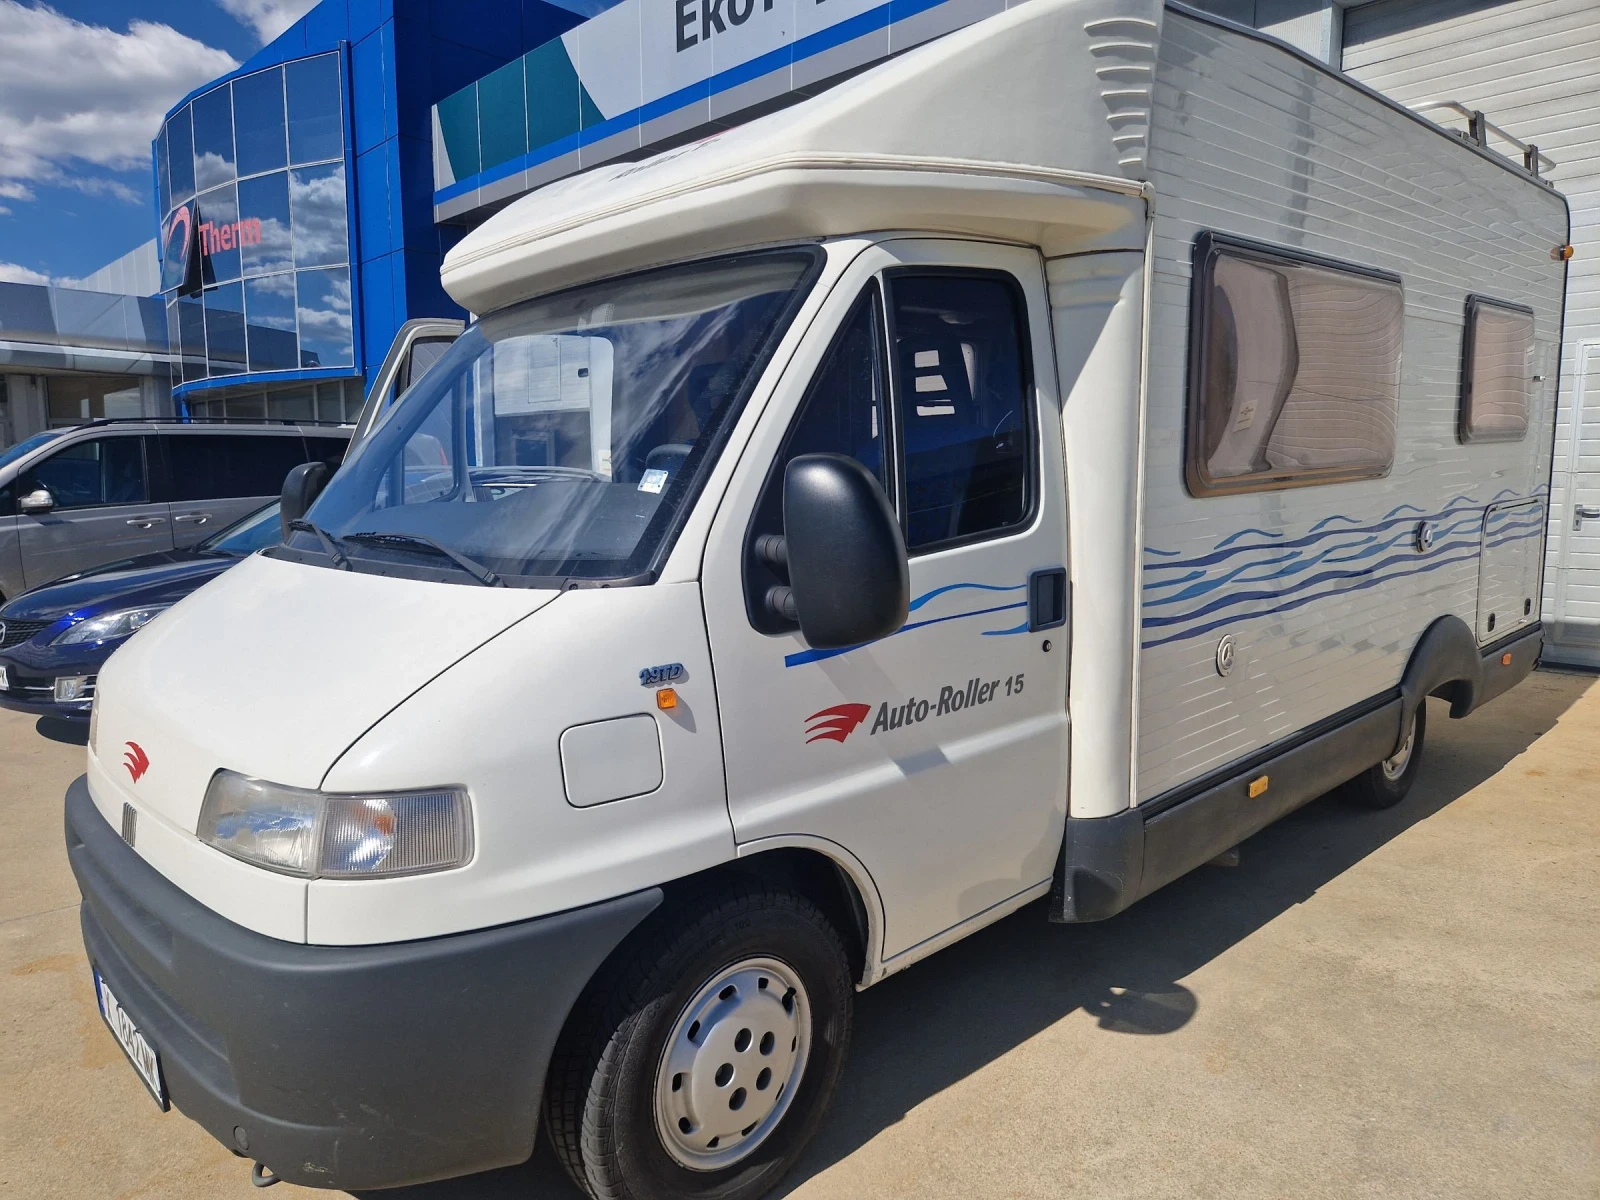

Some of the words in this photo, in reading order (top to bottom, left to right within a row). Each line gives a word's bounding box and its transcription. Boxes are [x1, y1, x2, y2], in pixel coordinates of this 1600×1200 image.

[199, 217, 262, 256] Therm
[870, 677, 1000, 736] Auto-Roller
[1005, 673, 1025, 697] 15
